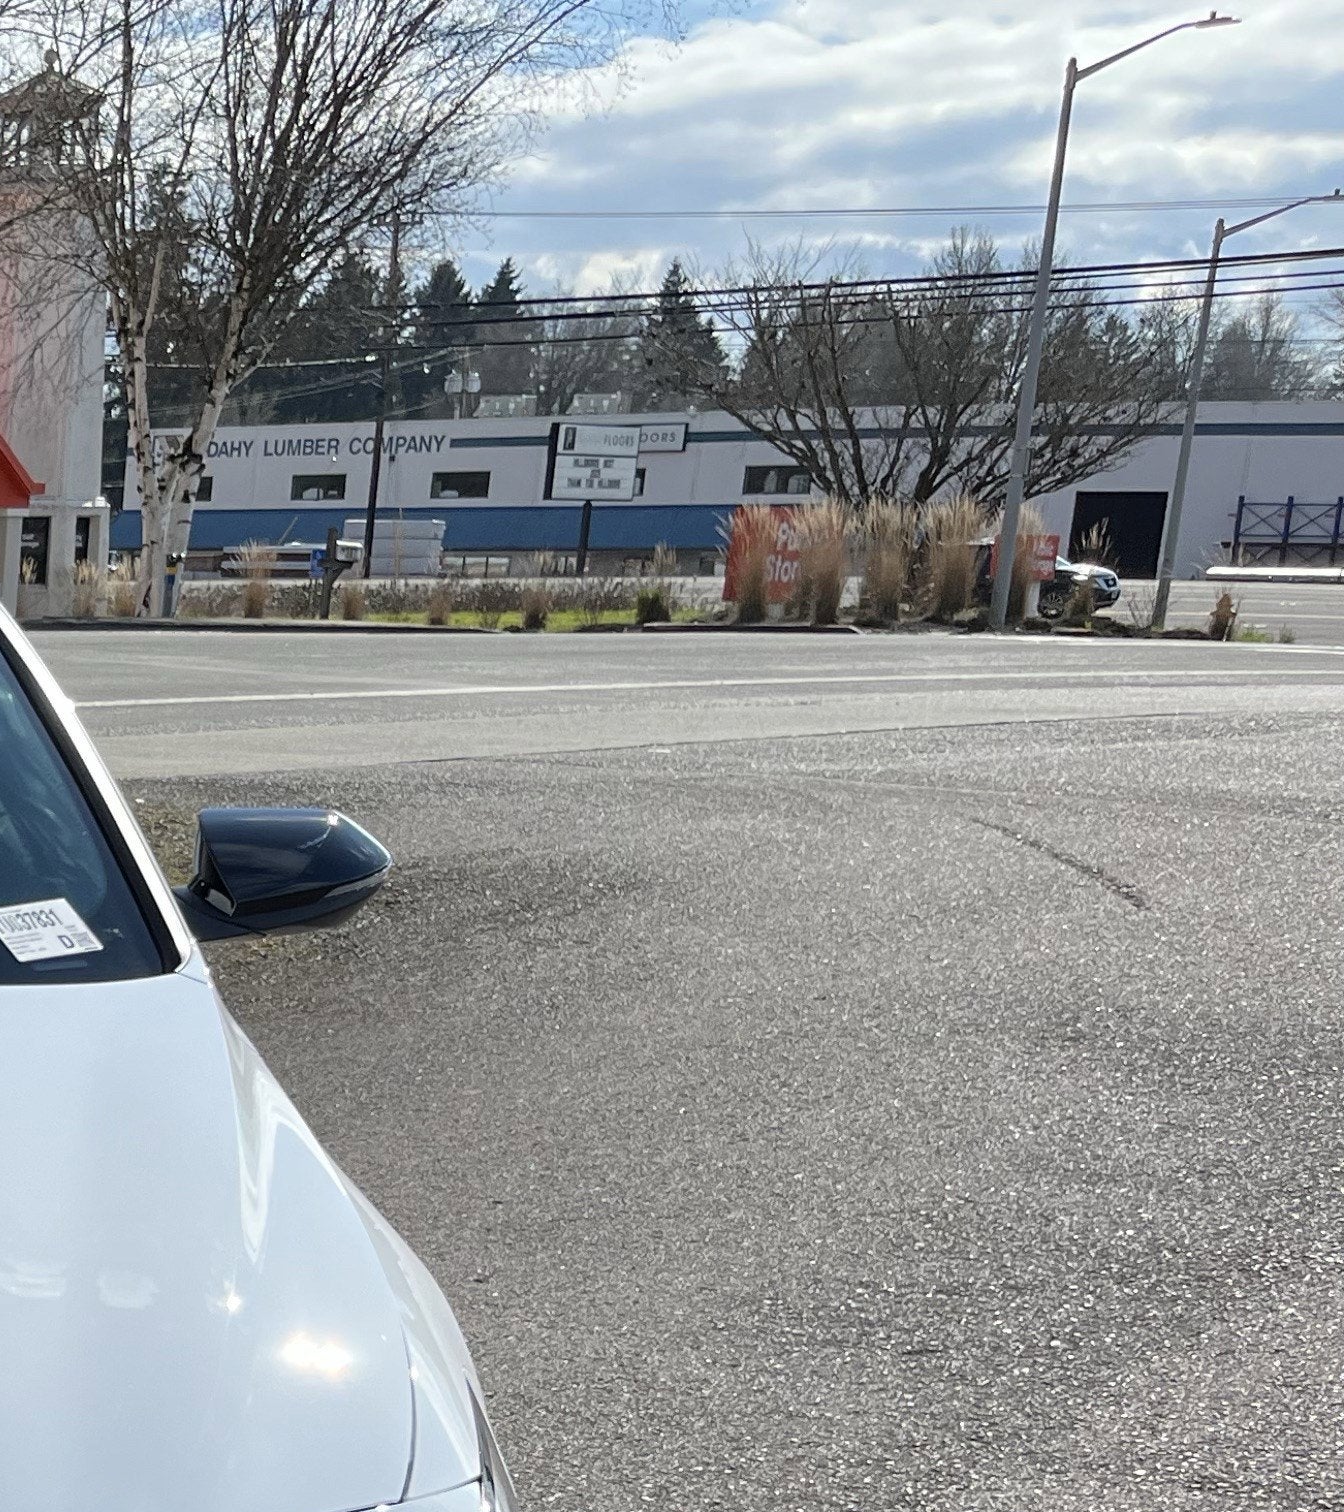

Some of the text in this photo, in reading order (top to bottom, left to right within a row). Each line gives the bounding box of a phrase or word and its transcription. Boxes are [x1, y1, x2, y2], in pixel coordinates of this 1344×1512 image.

[263, 438, 340, 457] LUMBER
[349, 435, 447, 456] COMPANY
[57, 935, 75, 949] D
